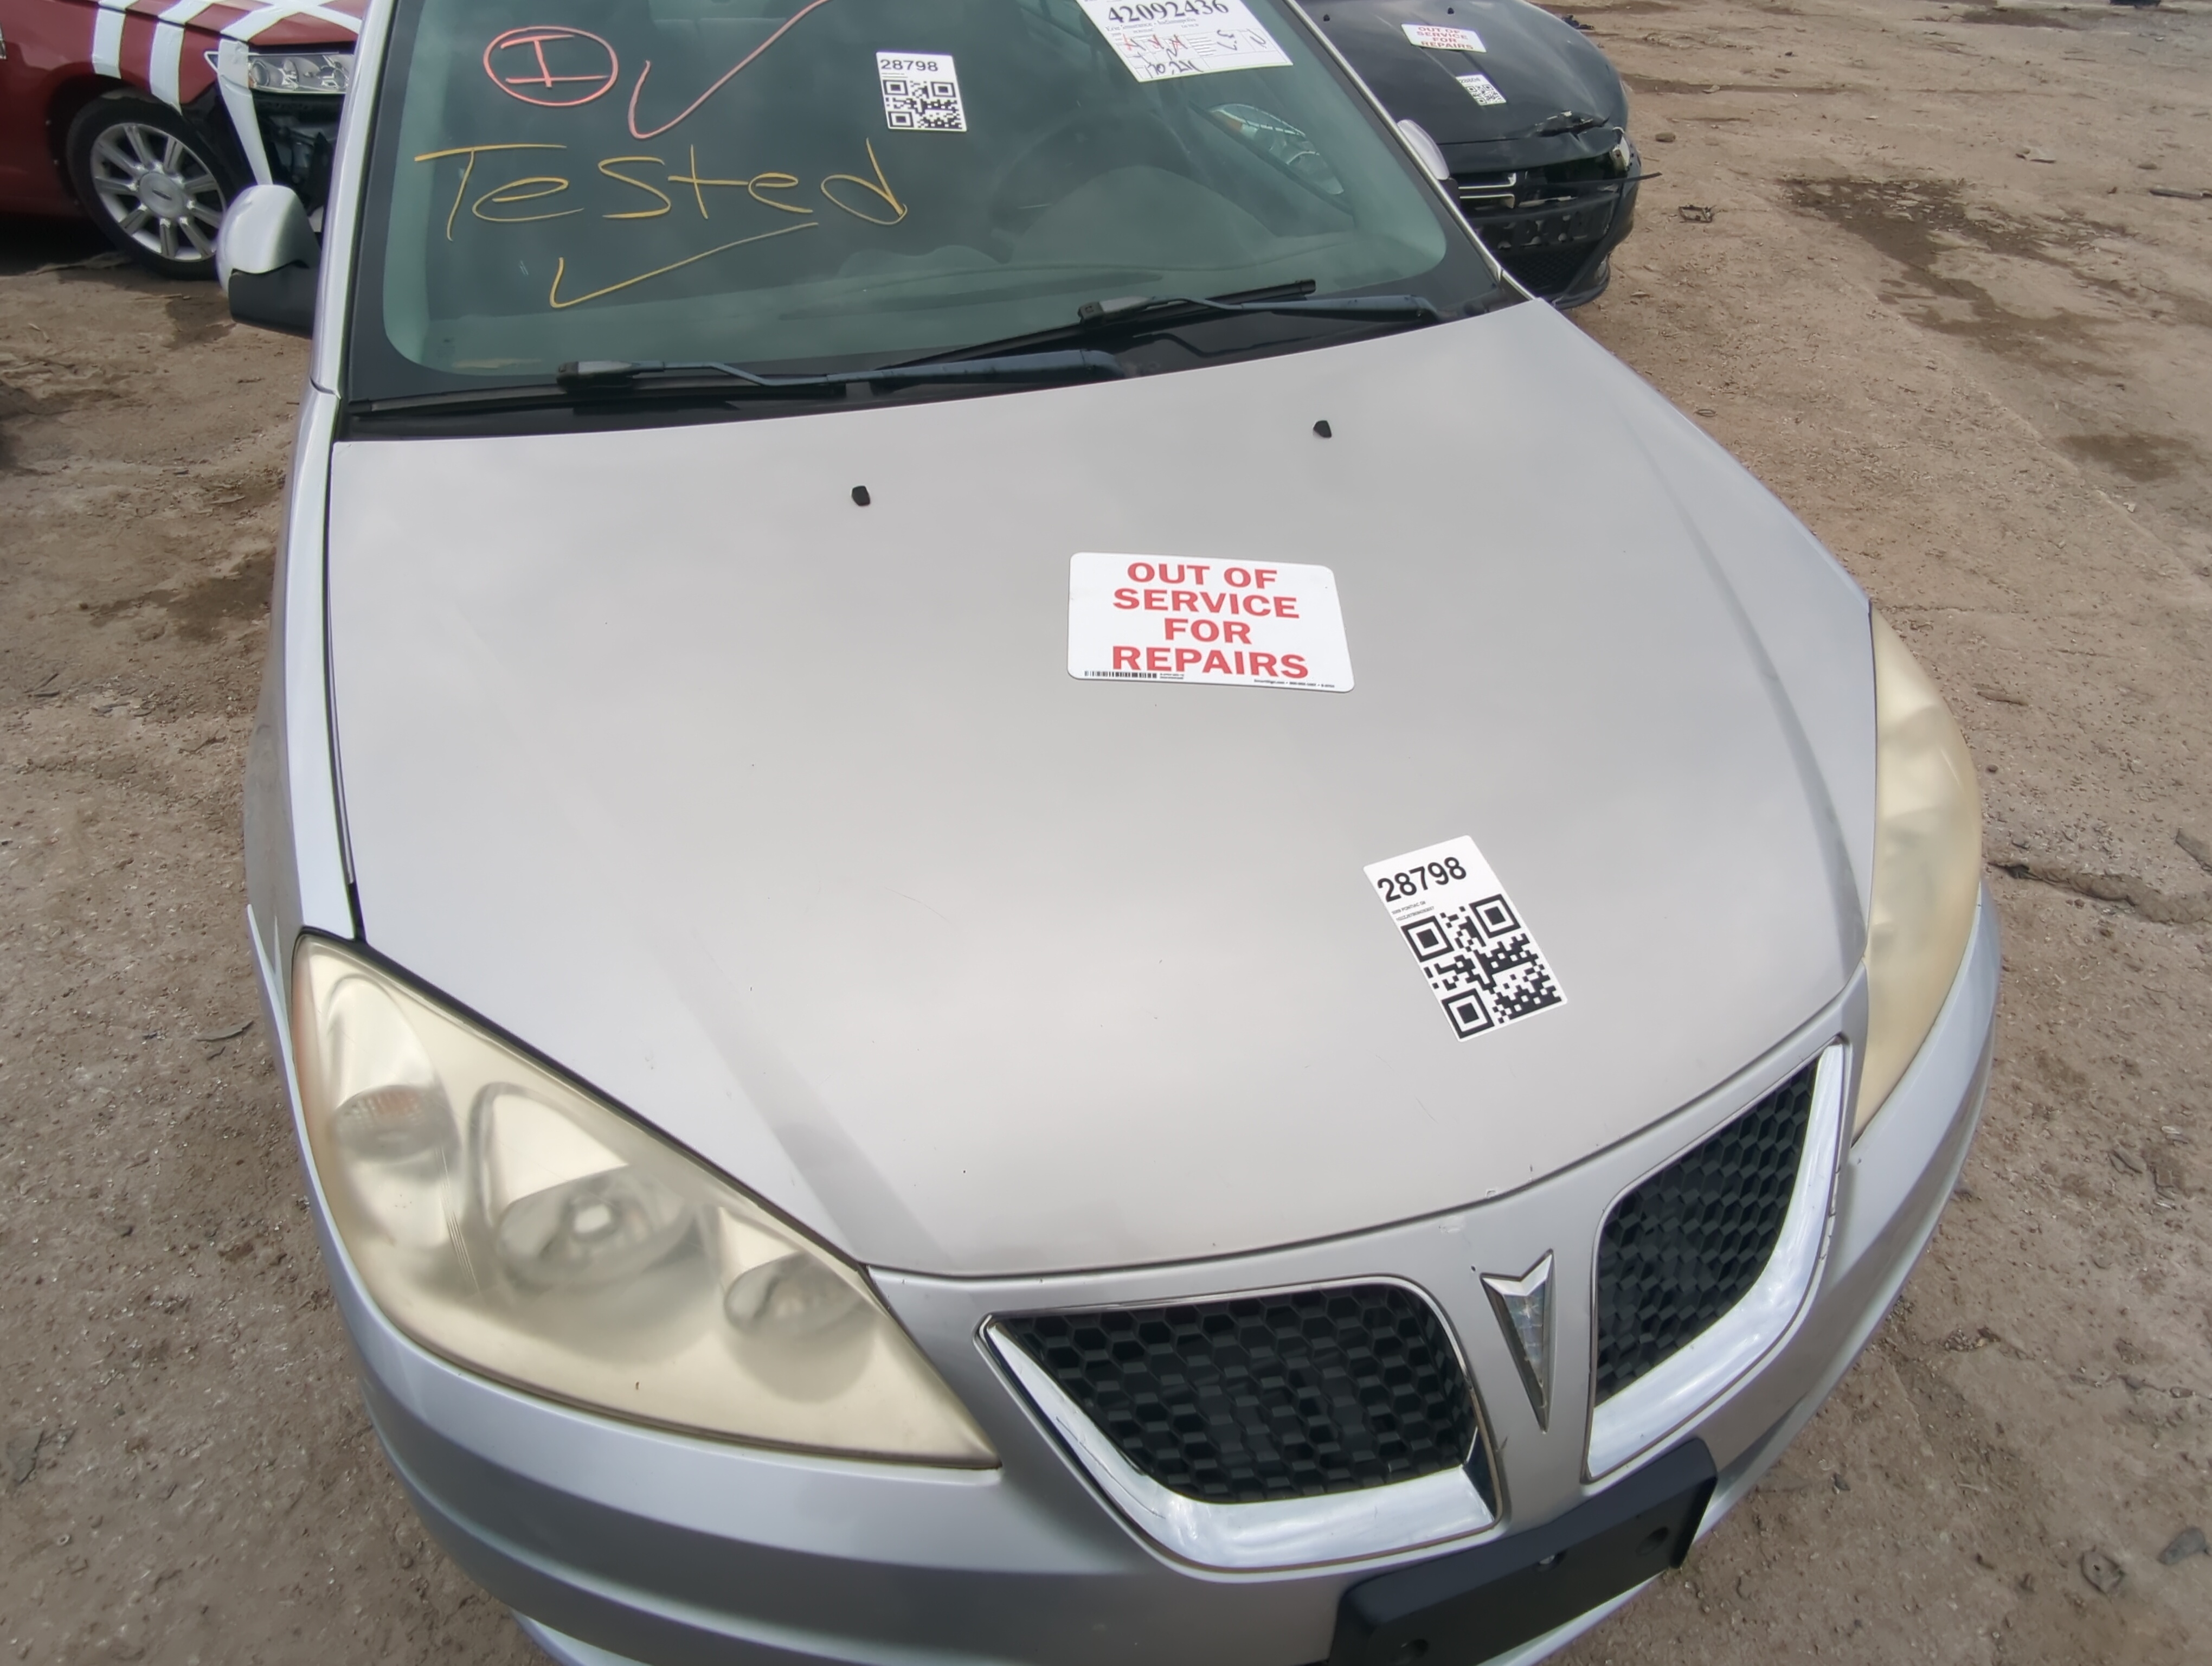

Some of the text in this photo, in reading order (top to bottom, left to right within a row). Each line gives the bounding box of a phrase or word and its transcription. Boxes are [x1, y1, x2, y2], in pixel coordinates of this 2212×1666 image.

[1108, 0, 1230, 23] 42092436
[1416, 31, 1469, 40] SERVICE
[1420, 41, 1474, 50] REPAIRS
[880, 59, 938, 72] 28798
[415, 137, 907, 242] Tested
[1127, 562, 1278, 589] OUT OF
[1113, 587, 1300, 619] SERVICE
[1164, 618, 1252, 644] FOR
[1113, 645, 1309, 679] REPAIRS
[1377, 857, 1467, 902] 28798
